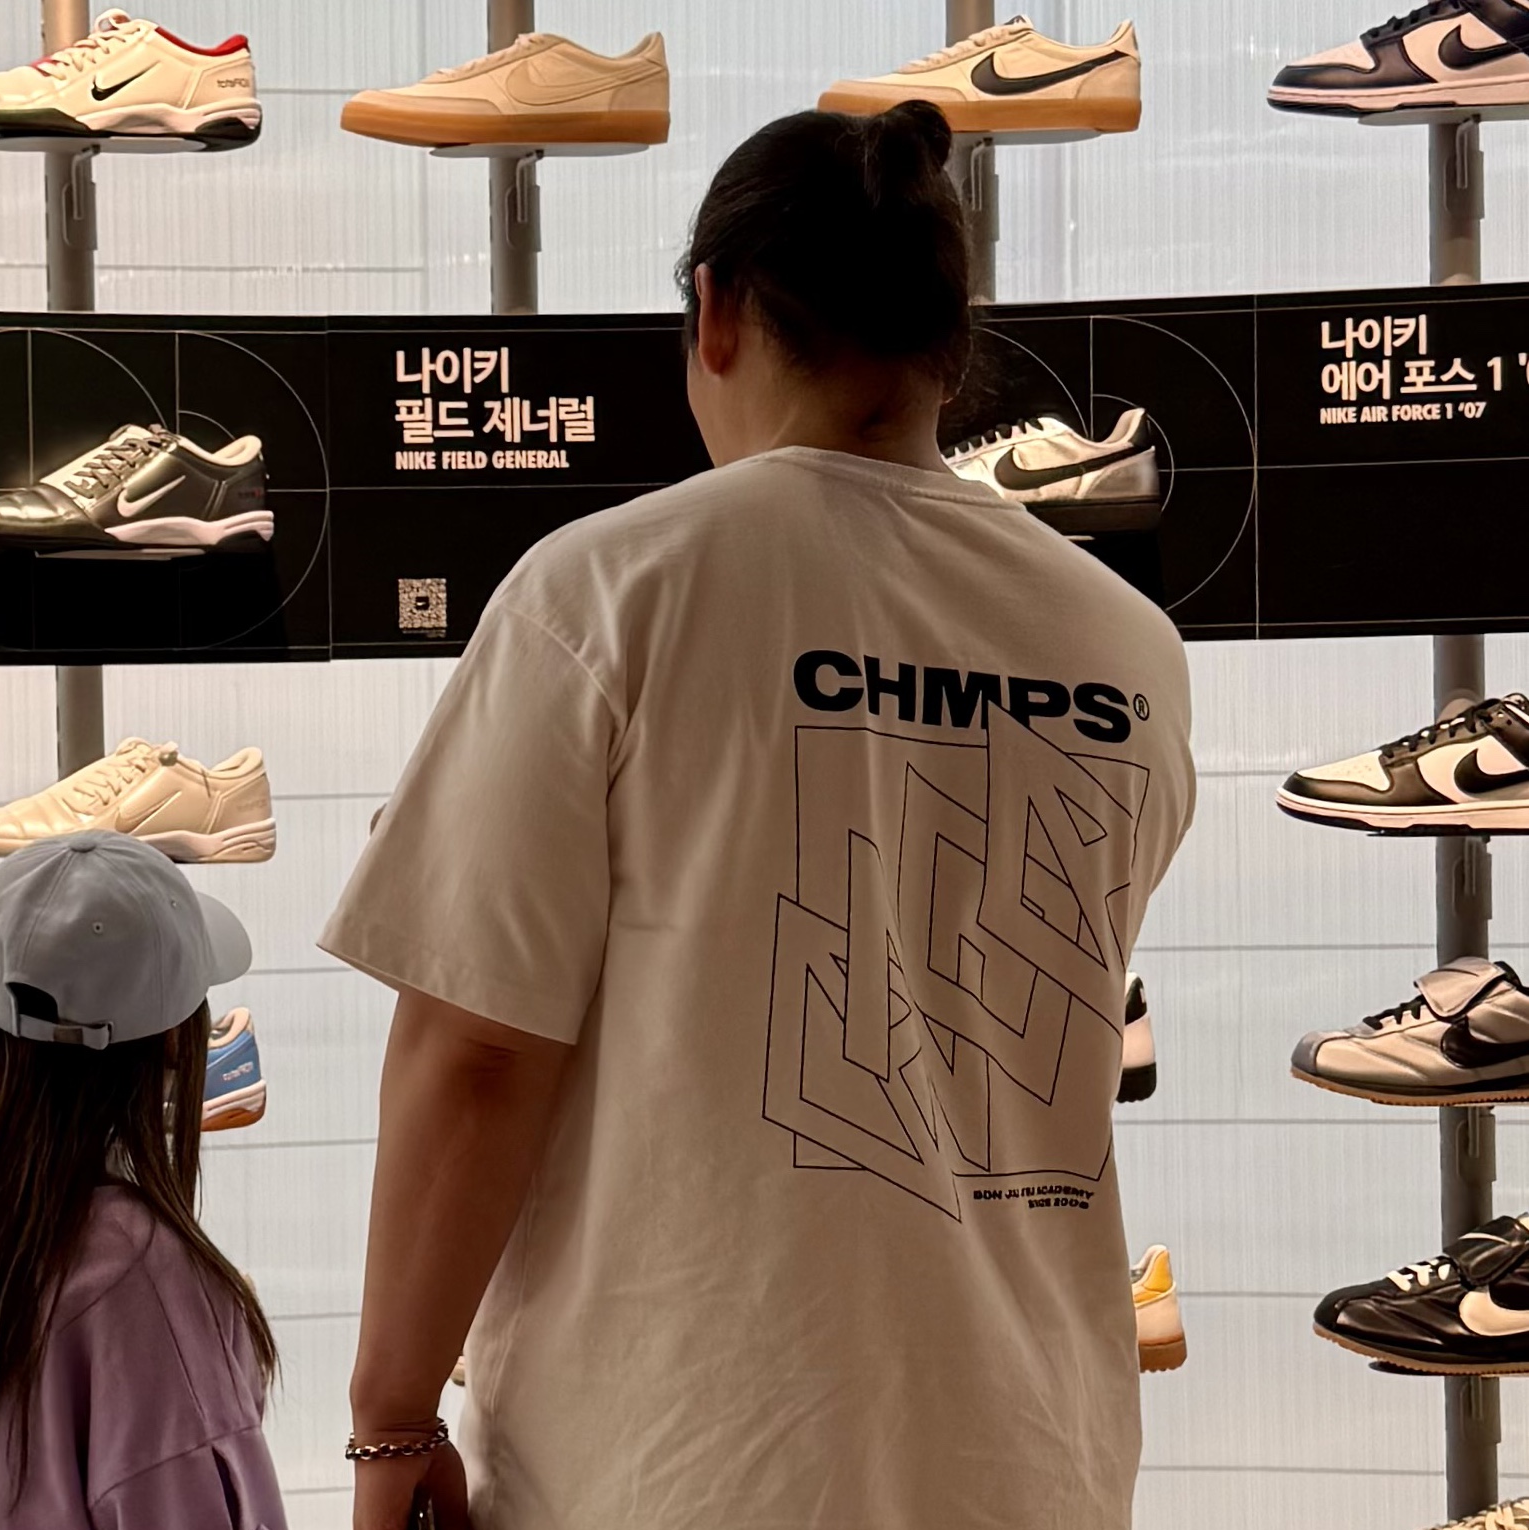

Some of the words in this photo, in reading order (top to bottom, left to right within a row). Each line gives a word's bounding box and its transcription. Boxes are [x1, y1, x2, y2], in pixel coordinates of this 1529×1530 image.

[1320, 313, 1428, 359] 나이키
[395, 346, 510, 394] 나이키
[1320, 359, 1391, 401] 에어
[1399, 357, 1478, 394] 포스
[1486, 356, 1502, 392] 1
[394, 397, 475, 444] 필드
[482, 396, 596, 443] 제너럴
[1319, 406, 1357, 425] NIKE
[1359, 405, 1389, 423] AIR
[1391, 403, 1441, 422] FORCE
[1444, 402, 1453, 420] 1
[395, 450, 437, 470] NIKE
[441, 450, 488, 470] FIELD
[491, 449, 570, 469] GENERAL
